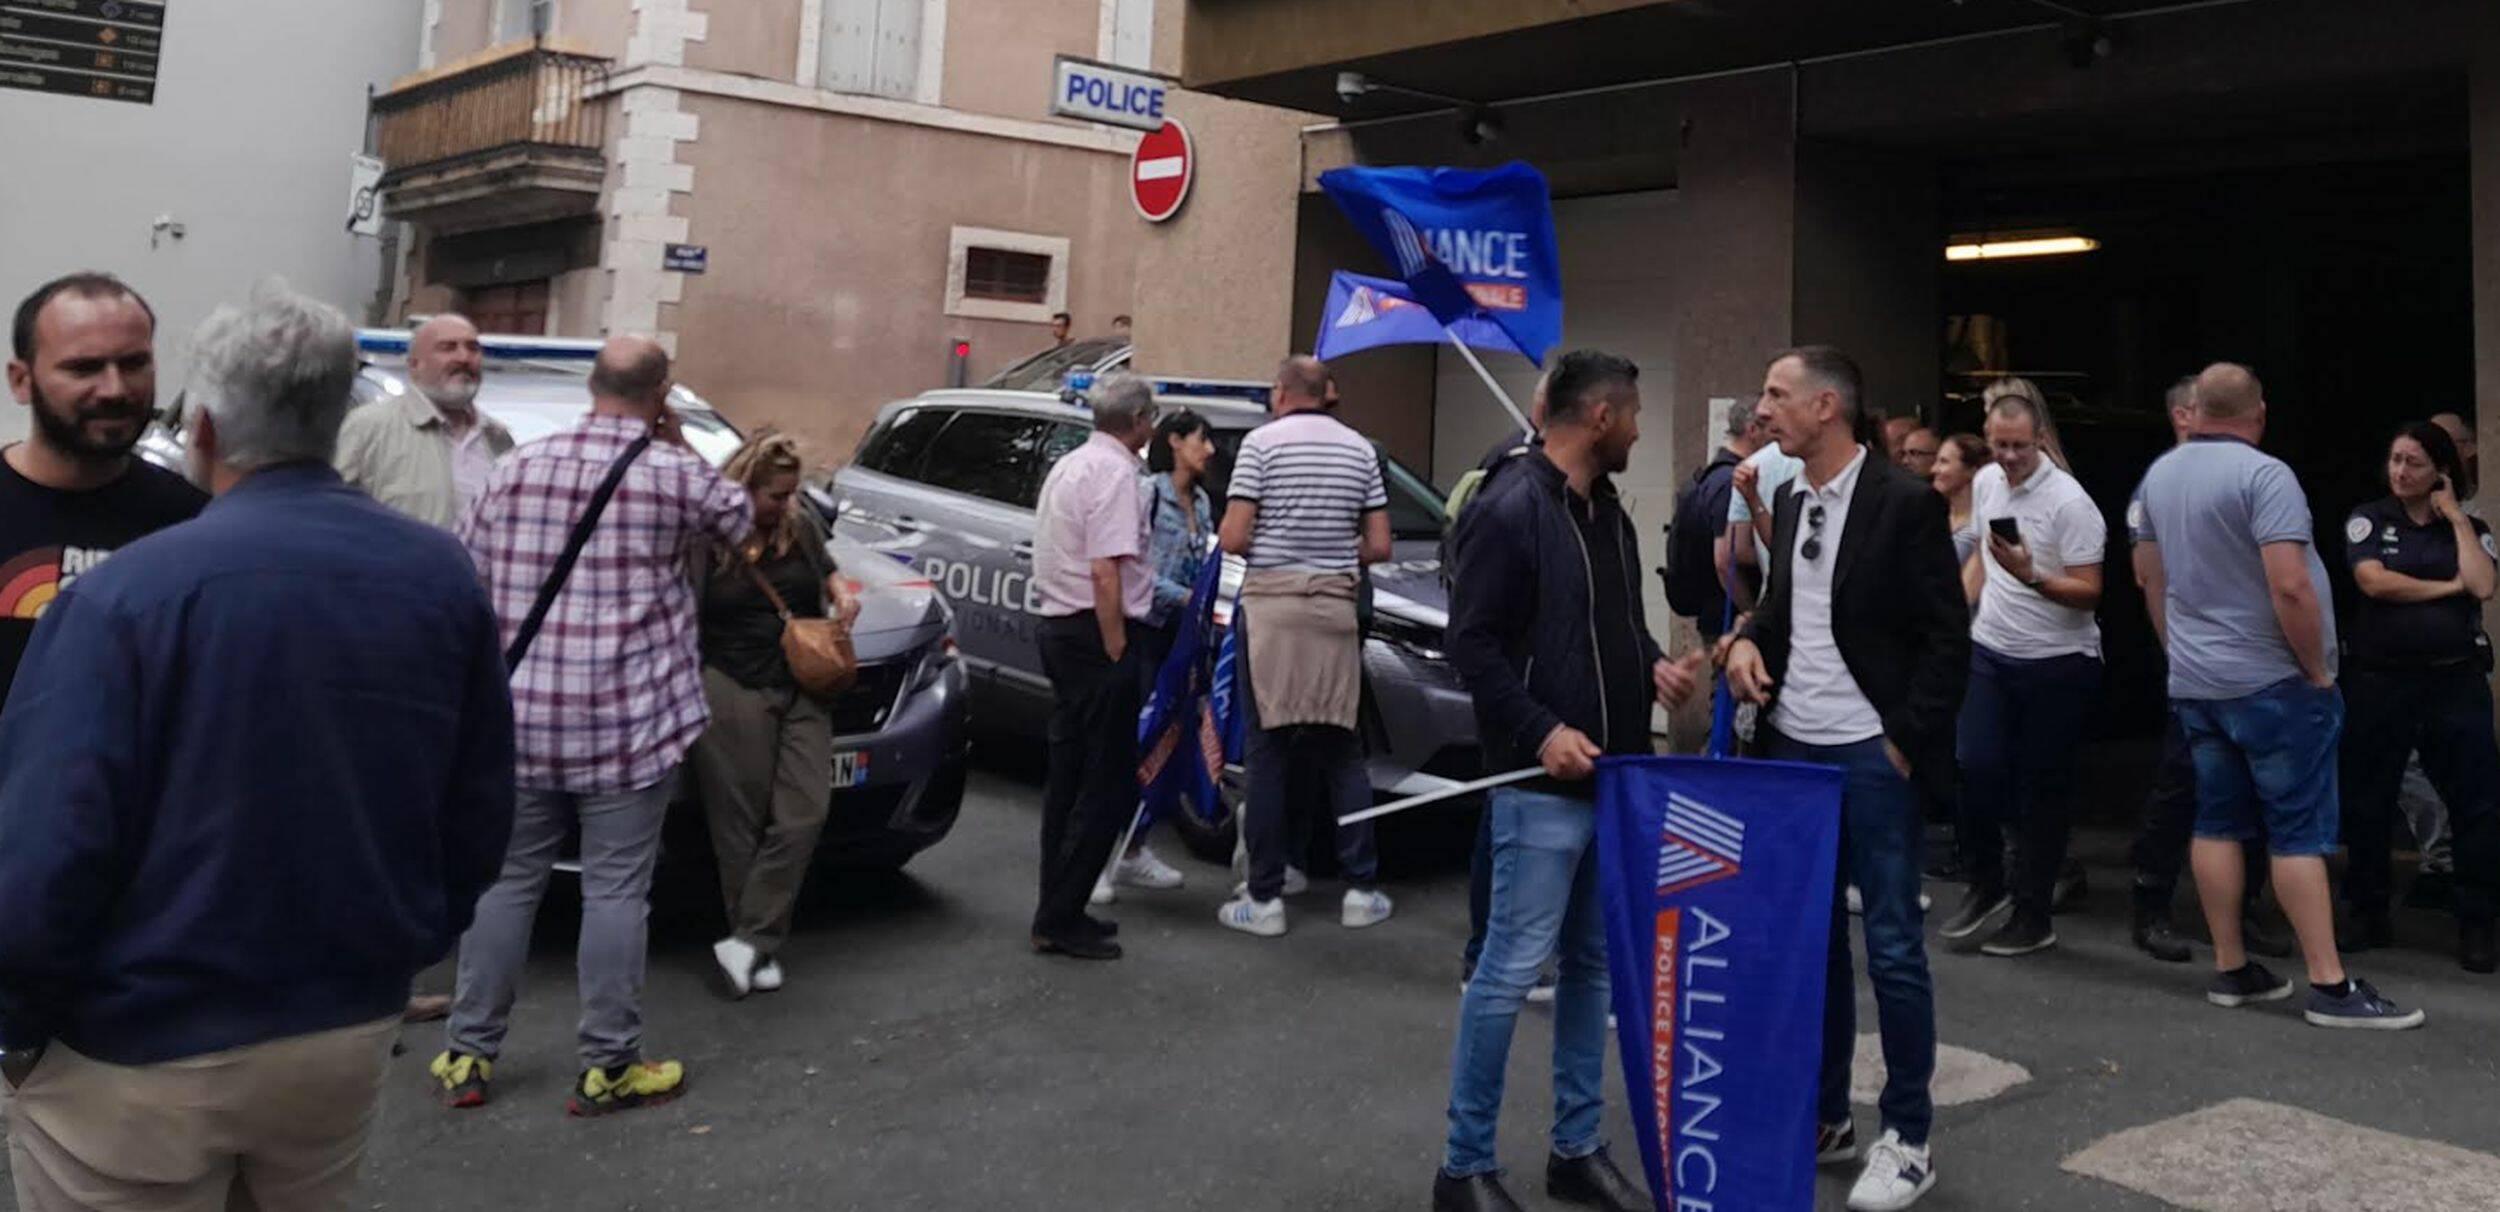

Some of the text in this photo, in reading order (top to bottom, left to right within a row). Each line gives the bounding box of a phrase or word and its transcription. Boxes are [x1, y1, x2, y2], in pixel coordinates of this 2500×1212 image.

[1067, 73, 1165, 118] POLICE
[924, 557, 1043, 616] POLICE
[1656, 935, 1673, 1032] POLICE
